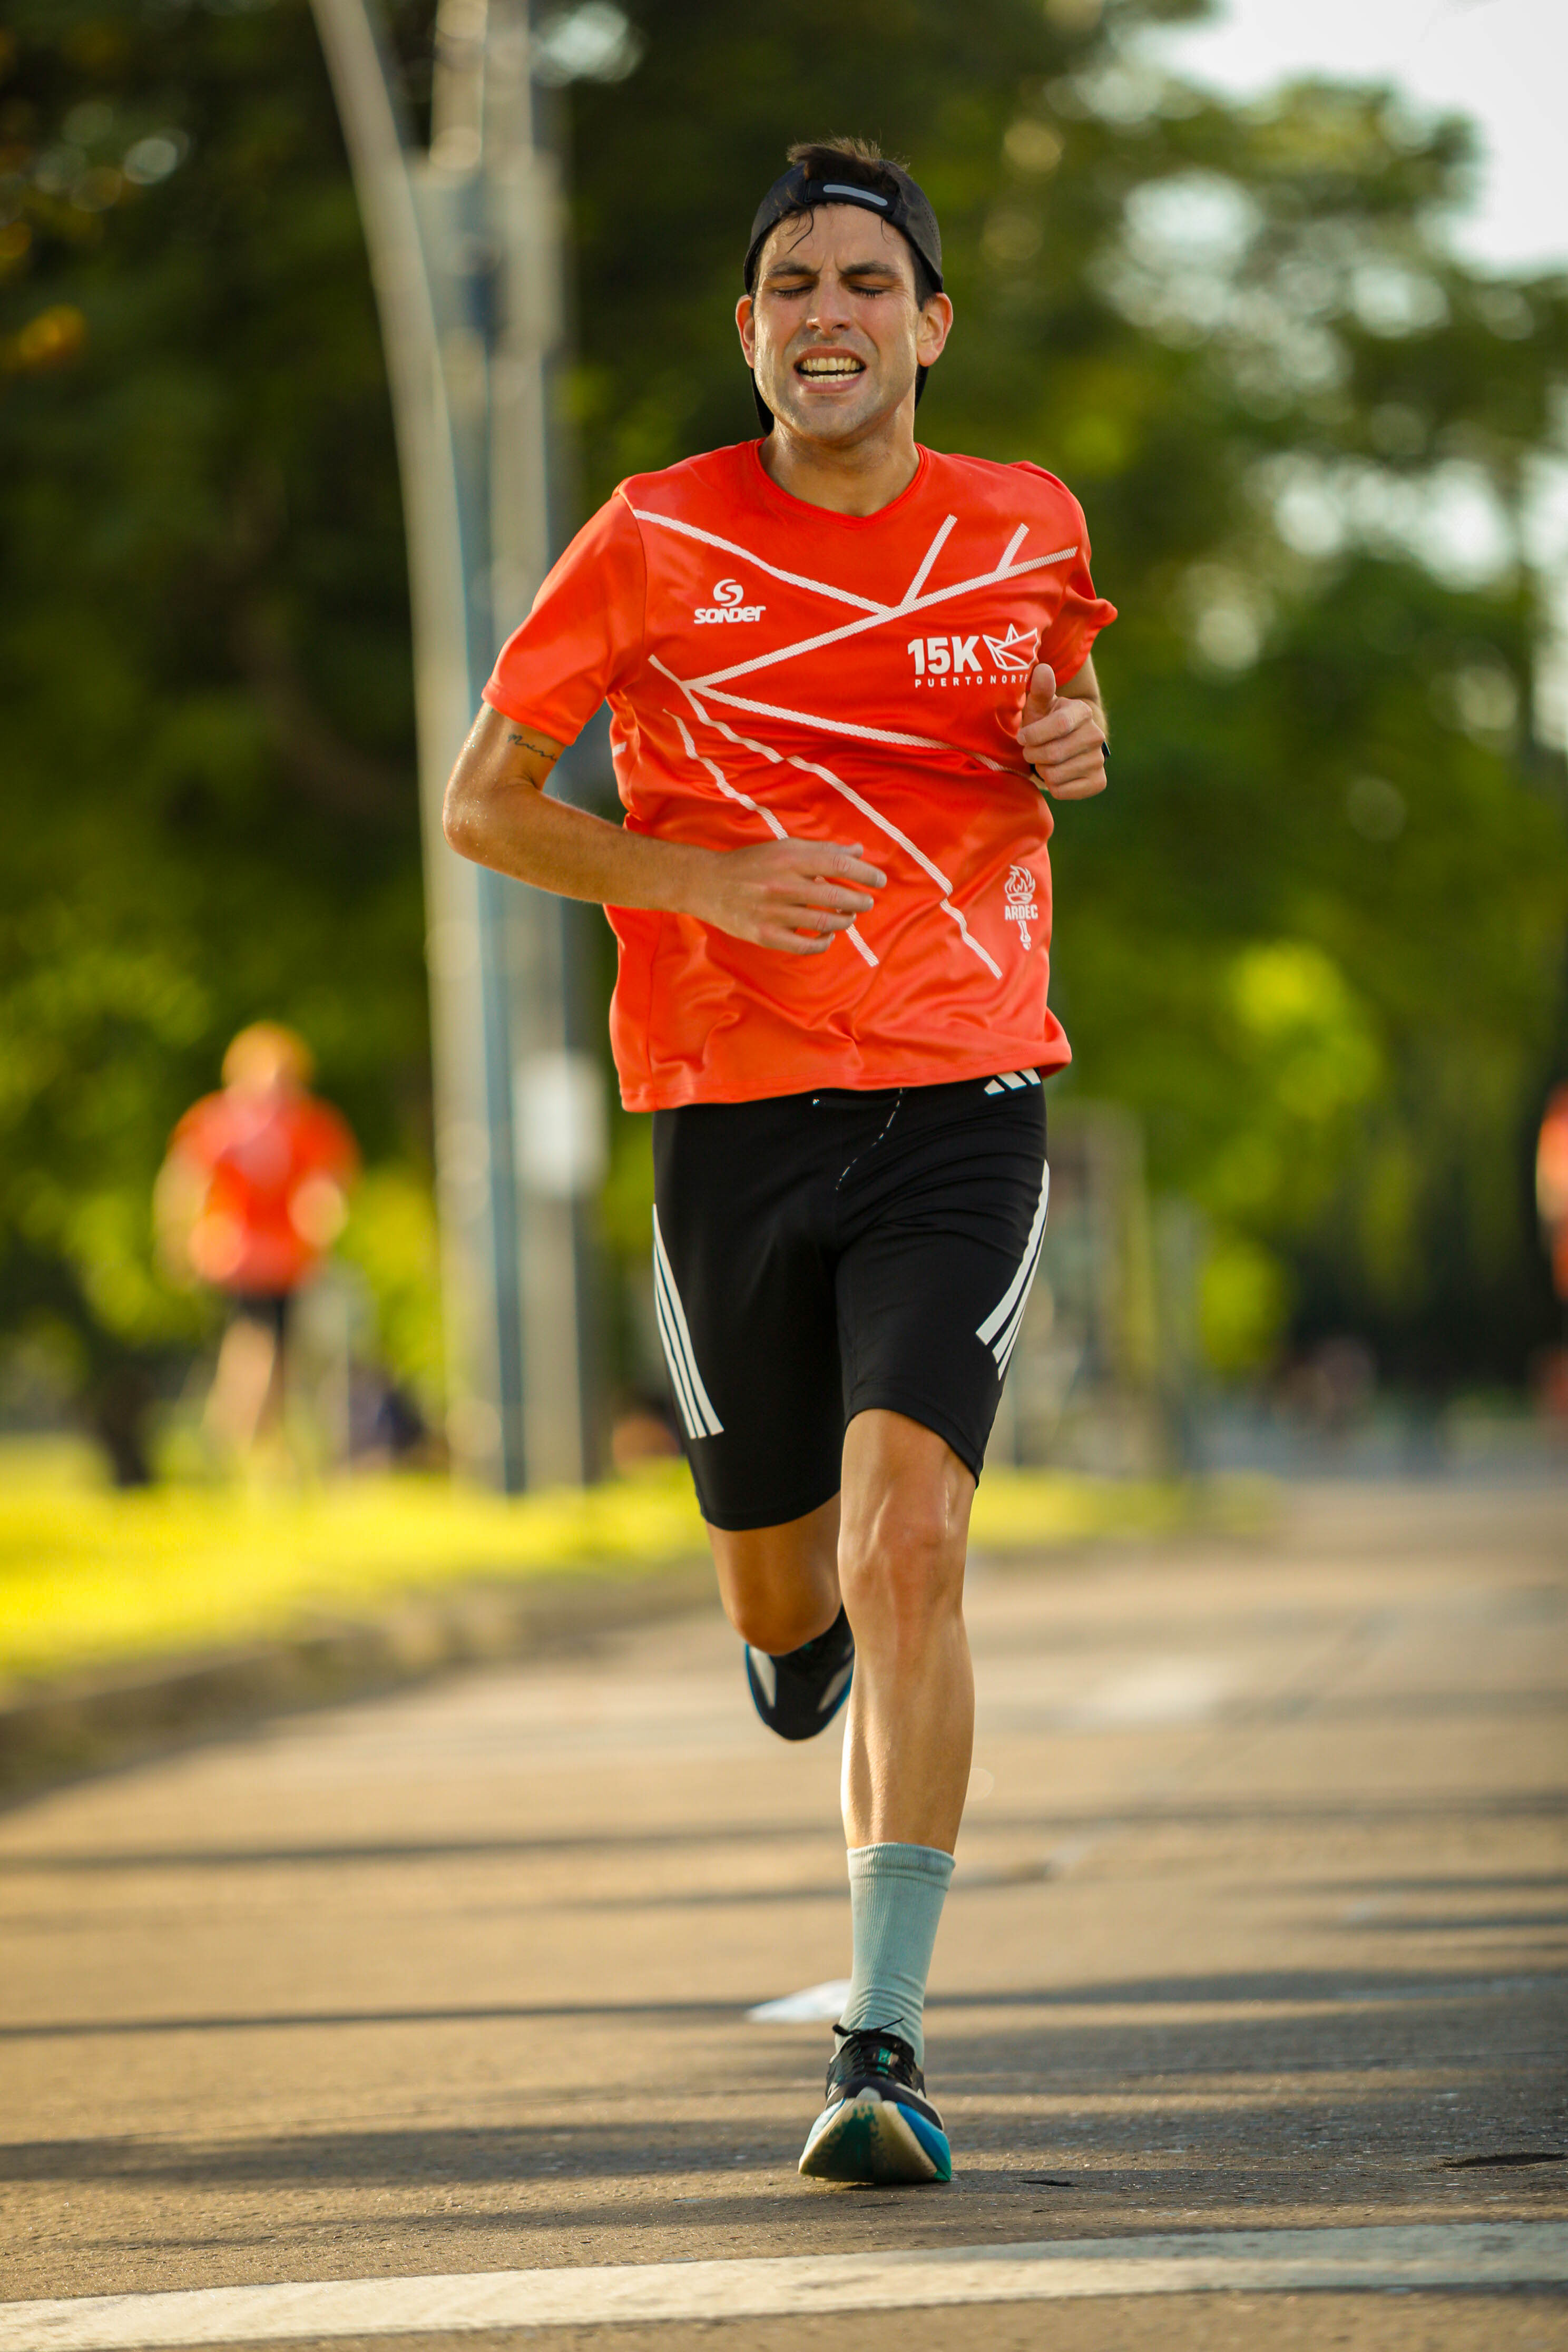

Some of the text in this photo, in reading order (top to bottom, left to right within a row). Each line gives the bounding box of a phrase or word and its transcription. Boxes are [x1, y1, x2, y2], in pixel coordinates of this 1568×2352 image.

[907, 636, 982, 675] 15K
[915, 677, 983, 688] PUERTO
[1005, 904, 1038, 920] ARDEC
